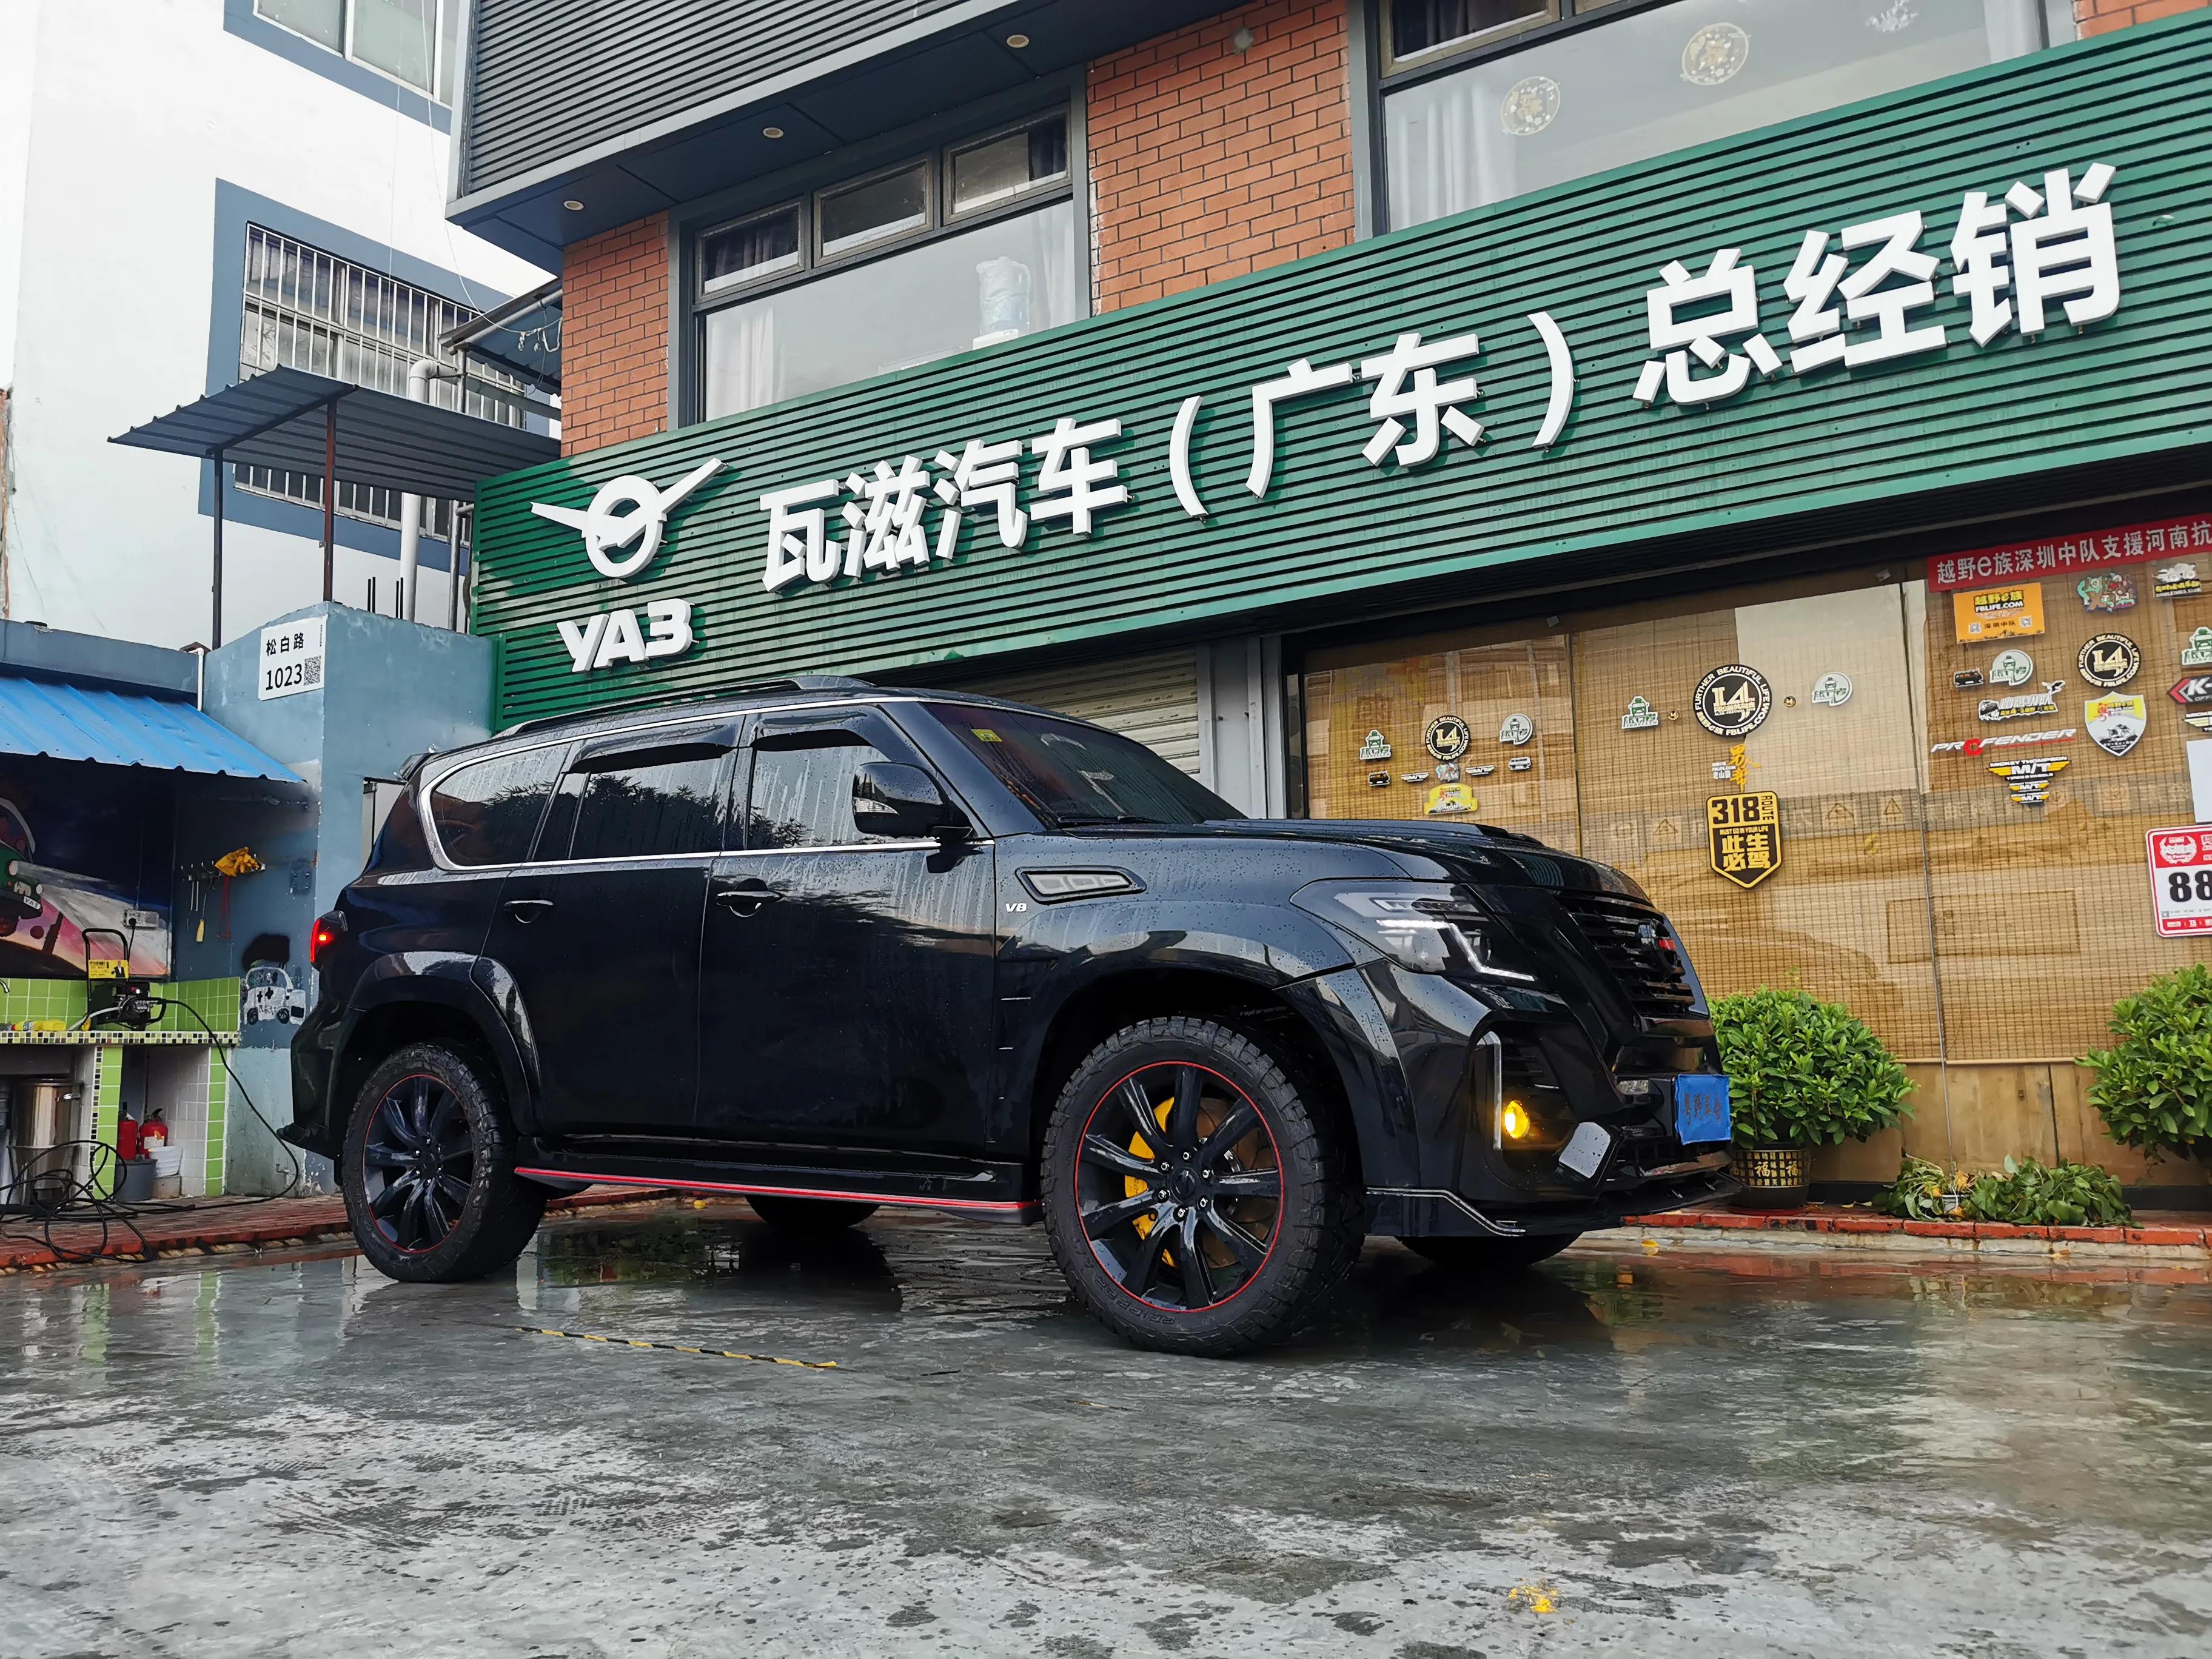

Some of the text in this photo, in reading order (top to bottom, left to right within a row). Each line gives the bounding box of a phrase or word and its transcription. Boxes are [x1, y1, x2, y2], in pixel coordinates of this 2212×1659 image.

[1976, 600, 2023, 612] FBLIFE.COM
[266, 632, 304, 657] 松白路
[266, 663, 303, 690] 1023
[1694, 673, 1715, 710] FURTHER
[1717, 666, 1761, 685] BEAUTIFUL
[1931, 728, 2077, 756] PROFENDER
[2011, 763, 2051, 775] M/T
[2022, 756, 2067, 765] THOMPSON
[1712, 795, 1774, 824] 318 ROUTE
[1721, 833, 1769, 854] 此生
[1723, 851, 1771, 872] 必驾
[1005, 903, 1027, 913] V8
[1754, 1161, 1771, 1178] 福
